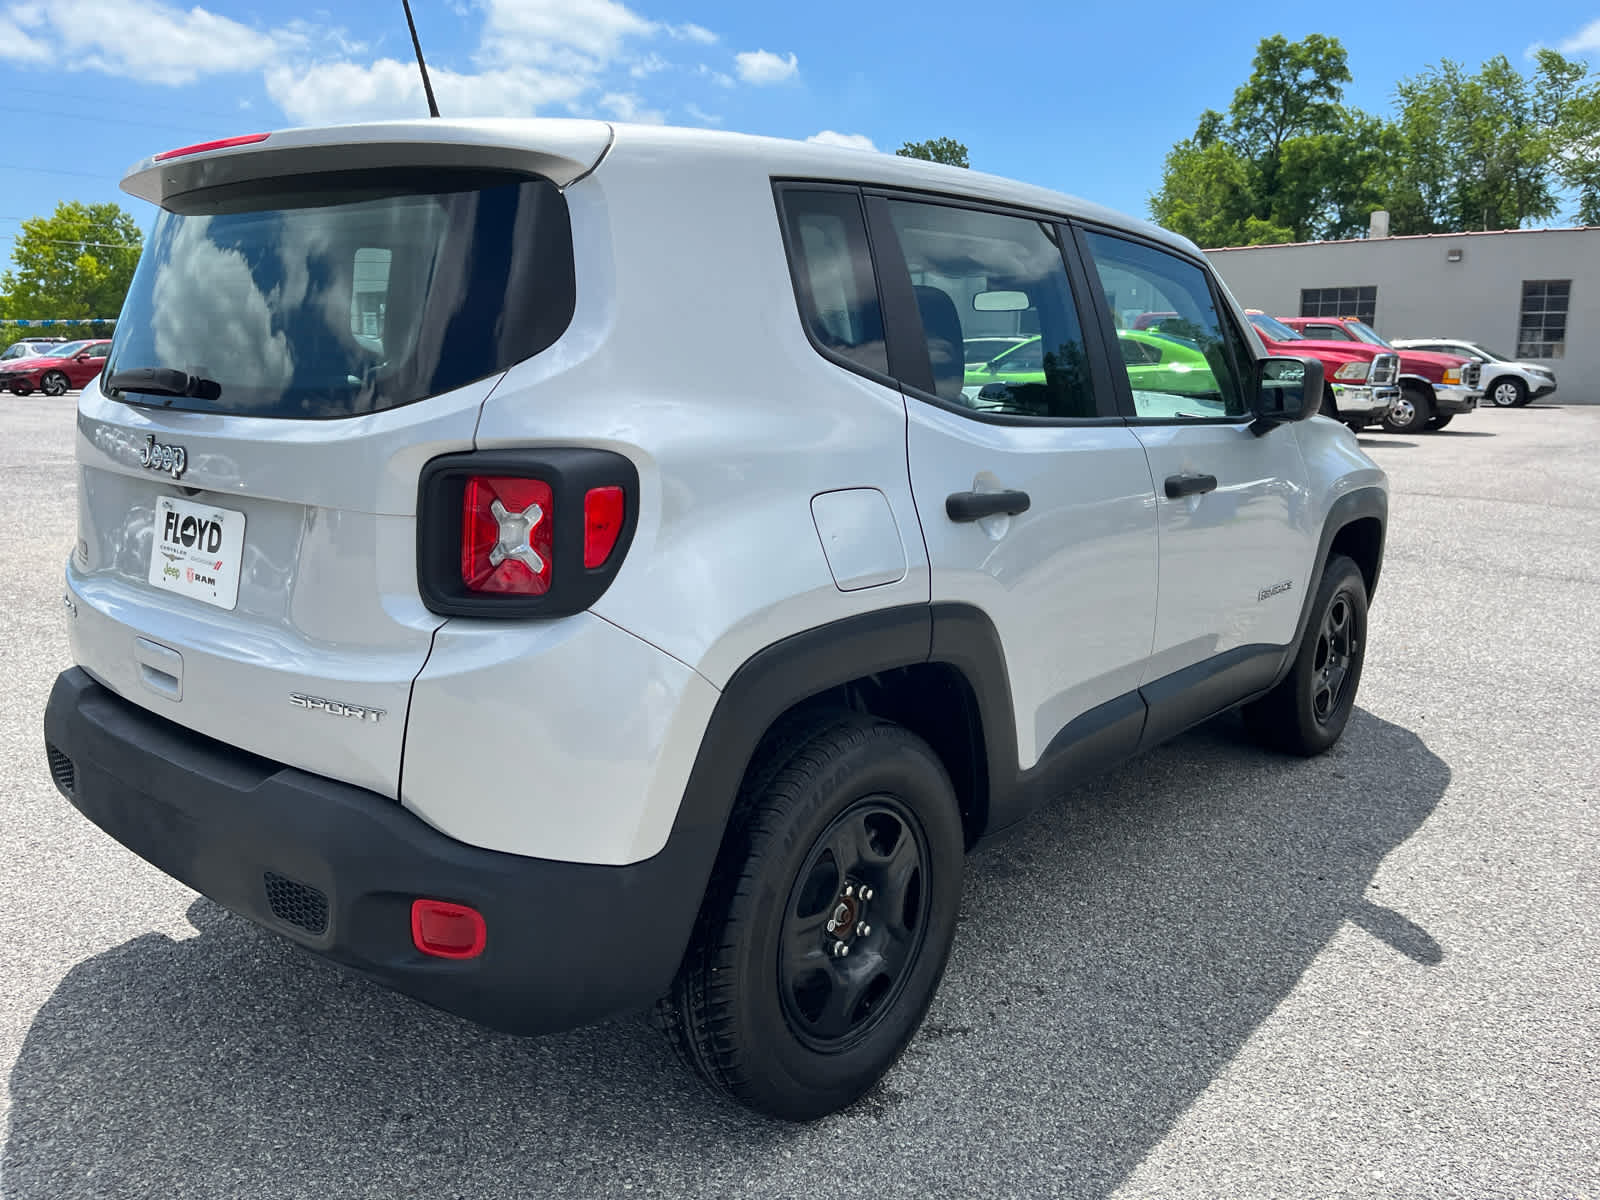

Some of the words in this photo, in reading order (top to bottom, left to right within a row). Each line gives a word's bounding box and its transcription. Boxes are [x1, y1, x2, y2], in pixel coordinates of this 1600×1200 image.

[141, 434, 188, 480] Jeep
[163, 511, 222, 553] FLOYD
[163, 561, 181, 580] Jeep
[195, 573, 216, 586] RAM
[289, 692, 387, 722] SPORT
